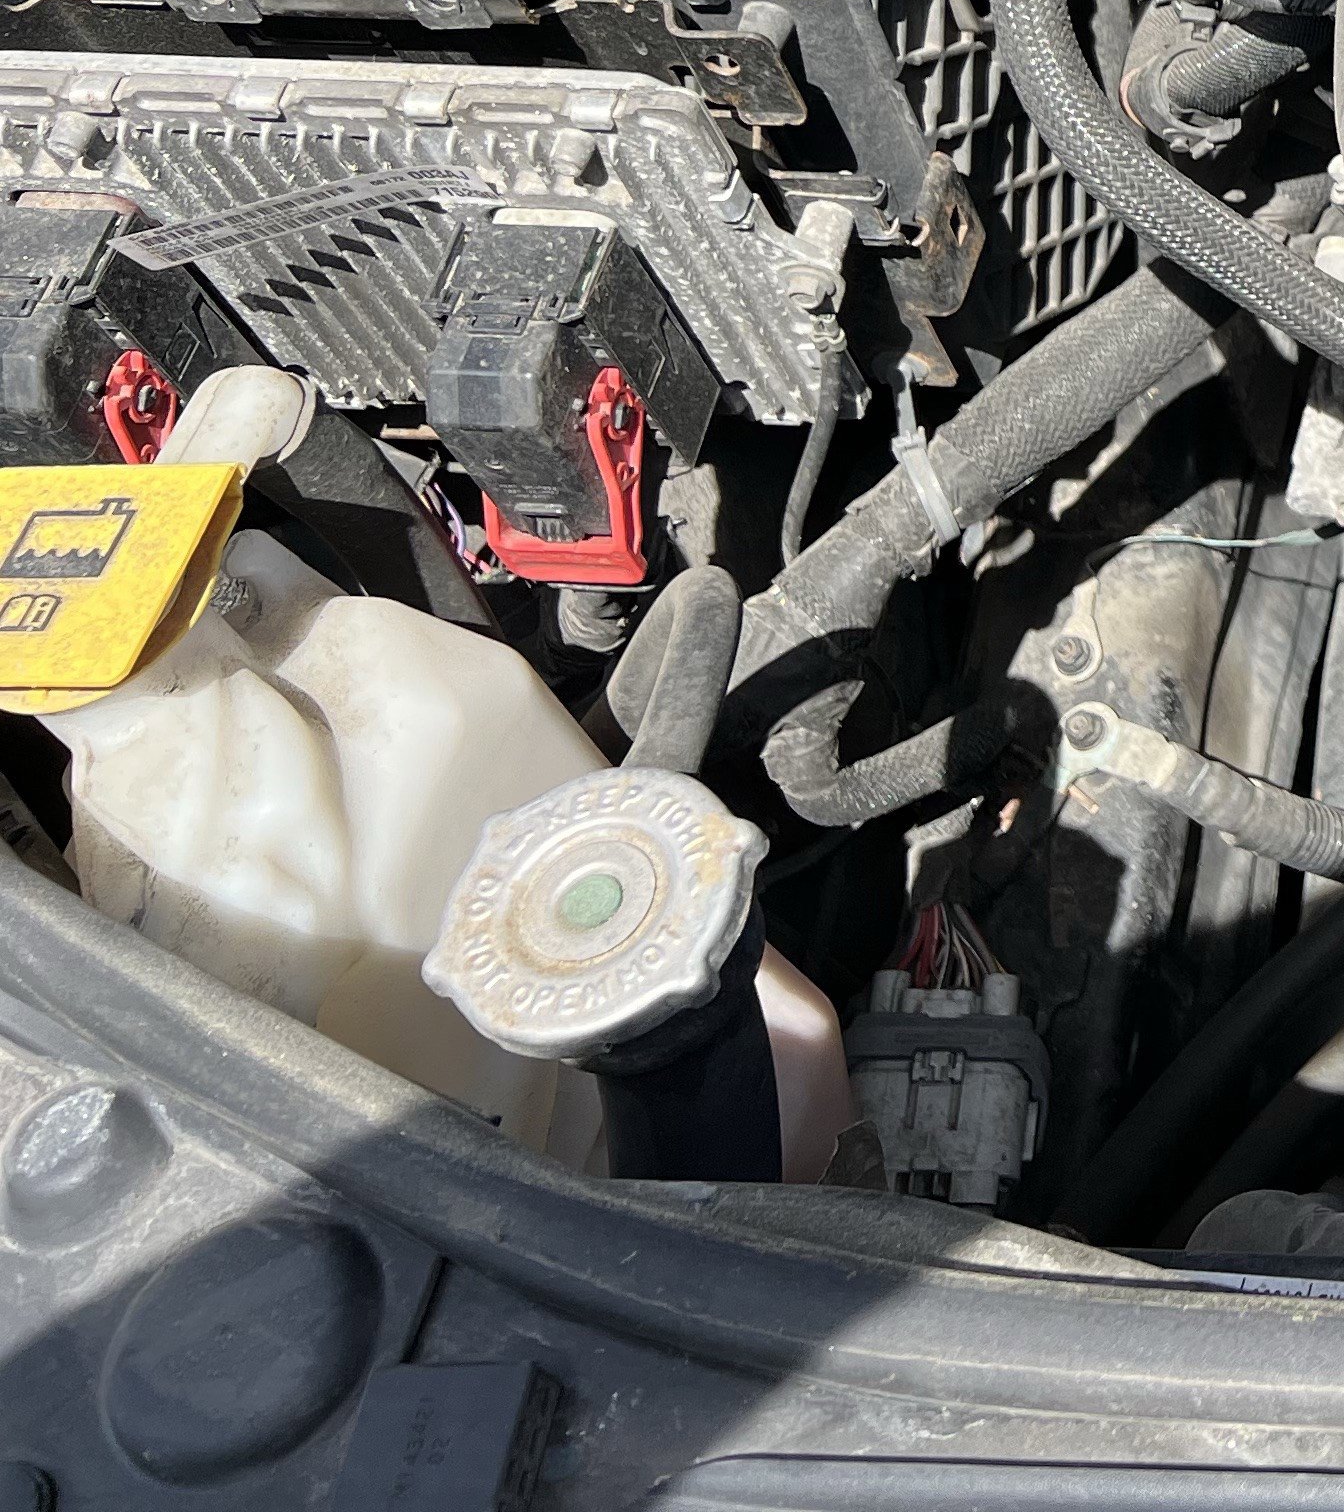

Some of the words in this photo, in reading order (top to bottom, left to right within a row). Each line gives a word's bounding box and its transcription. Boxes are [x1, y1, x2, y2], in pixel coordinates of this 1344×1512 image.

[548, 785, 644, 828] KEEP
[466, 875, 502, 922] DO
[462, 931, 513, 993] NOT
[509, 970, 617, 1018] OPEN
